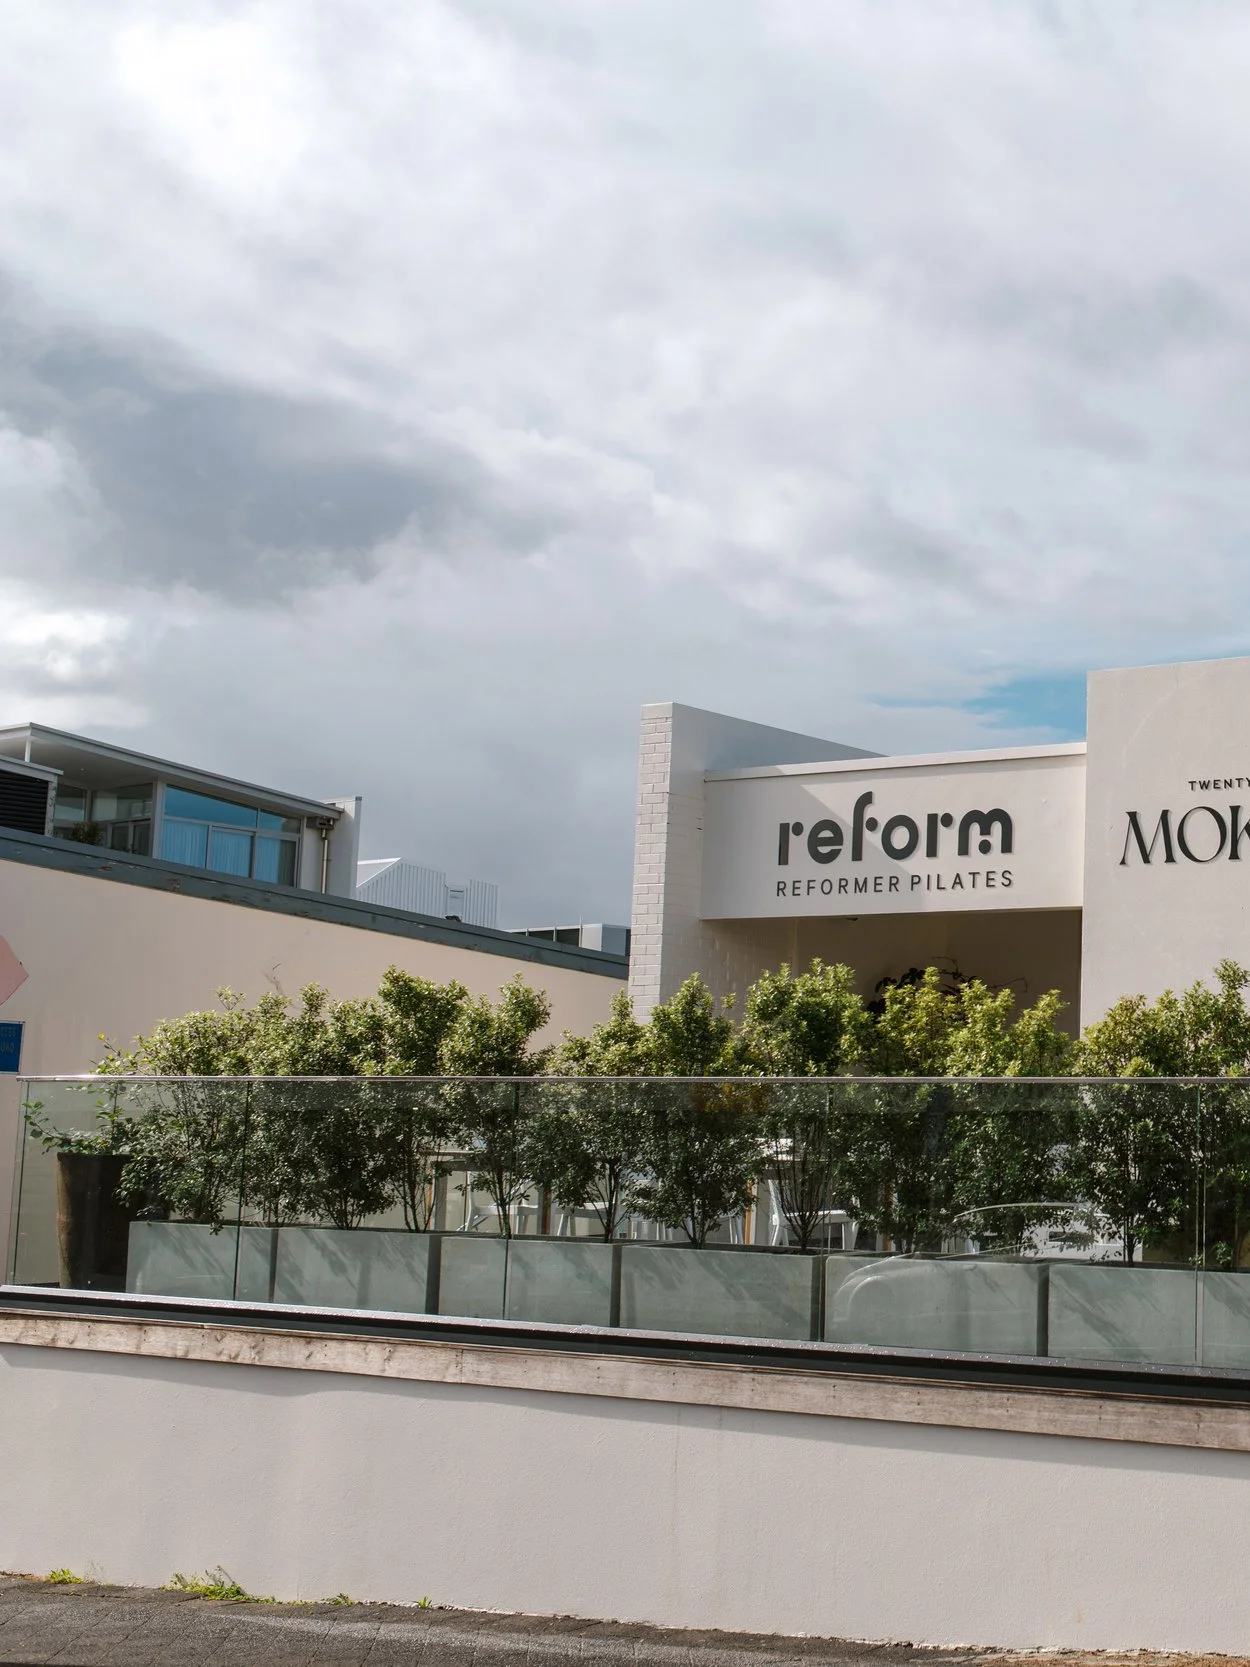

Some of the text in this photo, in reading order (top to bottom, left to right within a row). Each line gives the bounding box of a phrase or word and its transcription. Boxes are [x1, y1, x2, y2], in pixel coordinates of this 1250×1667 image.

[778, 792, 1013, 866] reform
[776, 870, 1013, 897] REFORMER PILATES
